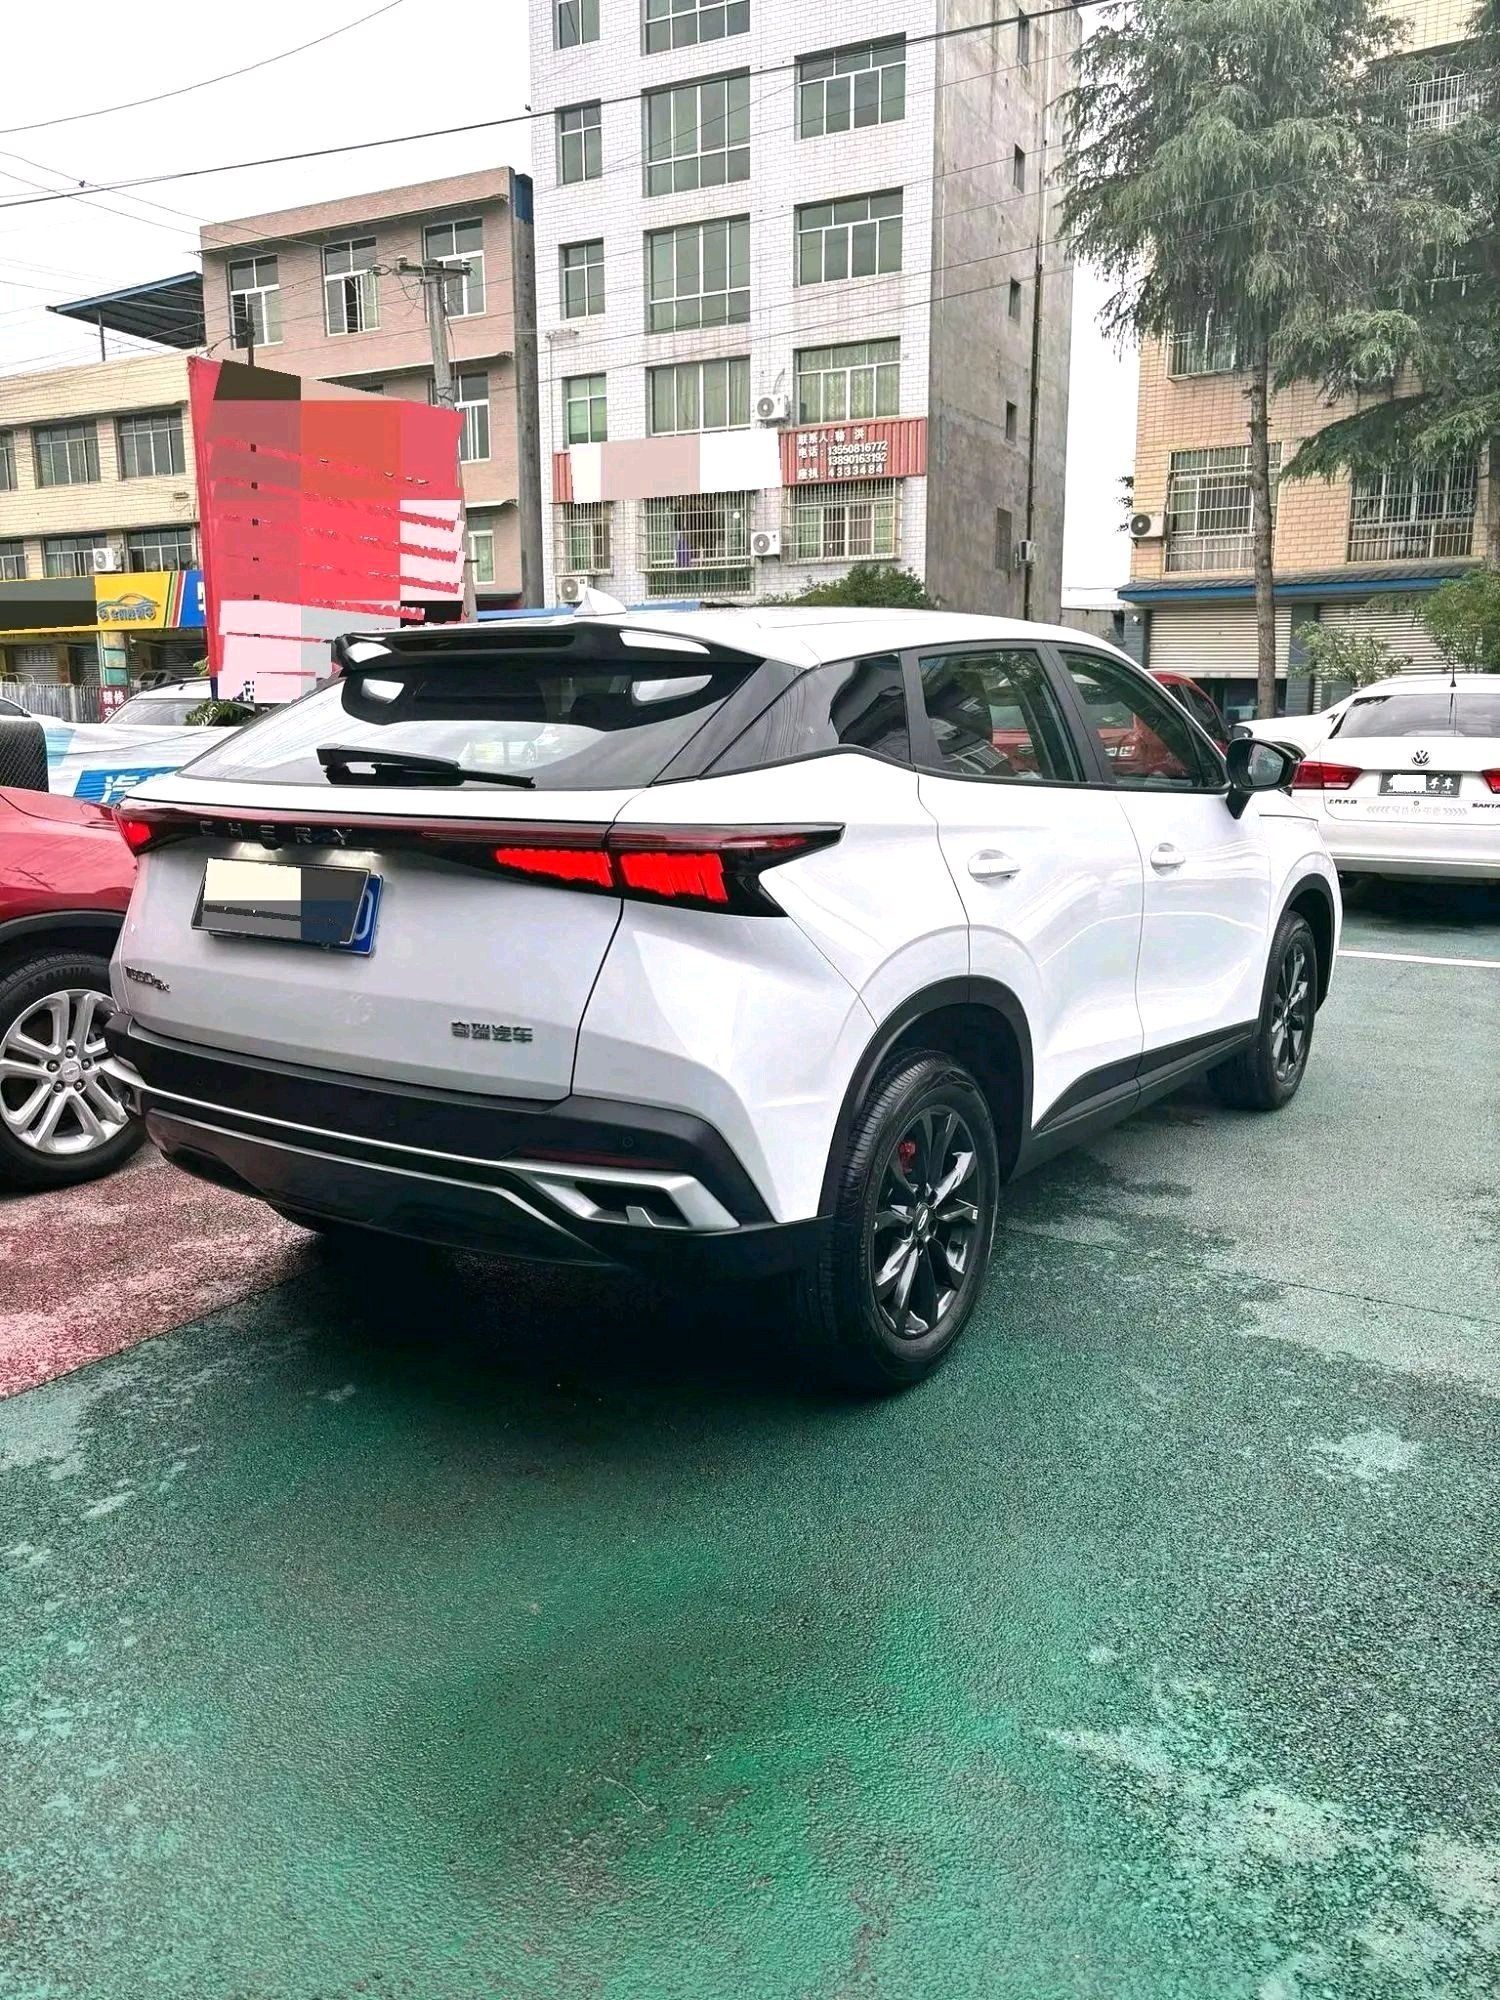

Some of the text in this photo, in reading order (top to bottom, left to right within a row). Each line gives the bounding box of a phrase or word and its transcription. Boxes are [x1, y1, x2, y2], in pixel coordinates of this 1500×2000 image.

[828, 452, 887, 466] 13890163192
[200, 820, 353, 846] CHERY
[451, 1021, 533, 1043] 奇瑞汽车
